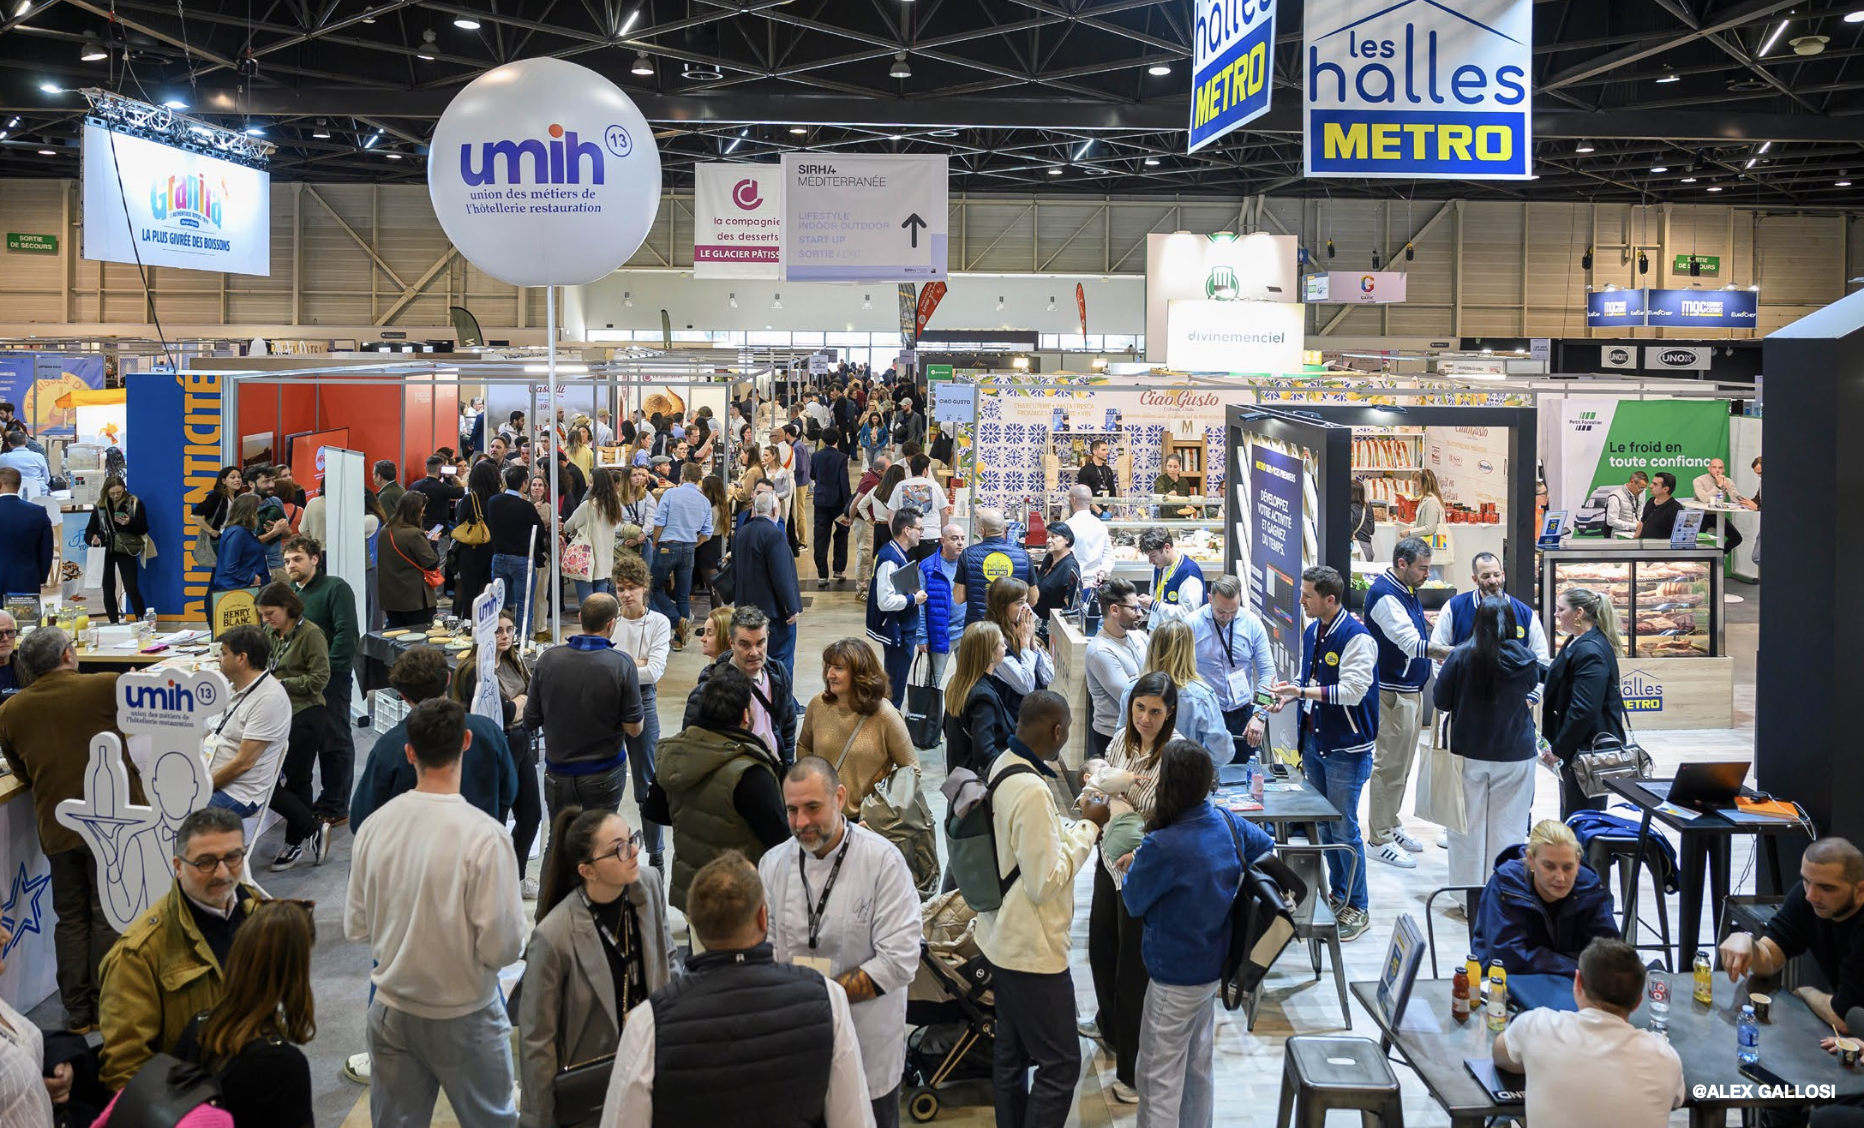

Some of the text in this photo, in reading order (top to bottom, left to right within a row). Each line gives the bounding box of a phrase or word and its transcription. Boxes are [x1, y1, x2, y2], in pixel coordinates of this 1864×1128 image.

[1349, 30, 1396, 59] les
[1309, 22, 1526, 105] halles
[1194, 41, 1266, 130] METRO
[1323, 122, 1513, 161] METRO
[460, 123, 628, 187] umih 13
[798, 174, 887, 188] MÉDITERRANÉE
[470, 188, 596, 200] union des métiers de
[466, 203, 602, 214] l'hôtellerie restauration
[713, 216, 780, 228] la compagnie
[798, 212, 849, 221] LIFESTYLE
[798, 222, 890, 231] INDOOR OUTDOOR
[142, 228, 231, 252] LA PLUS GIVRÉE DES BOISSONS
[717, 232, 779, 241] des desserts
[798, 235, 846, 244] START UP
[21, 242, 53, 250] SECOURS
[700, 249, 711, 258] LE
[712, 249, 750, 259] GLACIER
[798, 249, 834, 258] SORTIE
[1187, 329, 1285, 344] divinemenciel
[1140, 390, 1219, 409] Ciao Gusto
[1609, 441, 1682, 453] Le froid en
[1609, 455, 1711, 468] toute confianc
[1260, 488, 1289, 513] DÉVELOPPEZ
[1257, 501, 1292, 529] VOTRE ACTIVITÉ
[1261, 519, 1286, 542] ET GAGNEZ
[1261, 533, 1285, 556] DU TEMPS.
[223, 607, 250, 619] HENRY
[223, 616, 251, 627] BLANC
[1621, 678, 1633, 686] les
[1622, 676, 1663, 696] alles
[125, 679, 212, 712] umih 13
[159, 711, 181, 719] métiers
[159, 719, 194, 728] restauration
